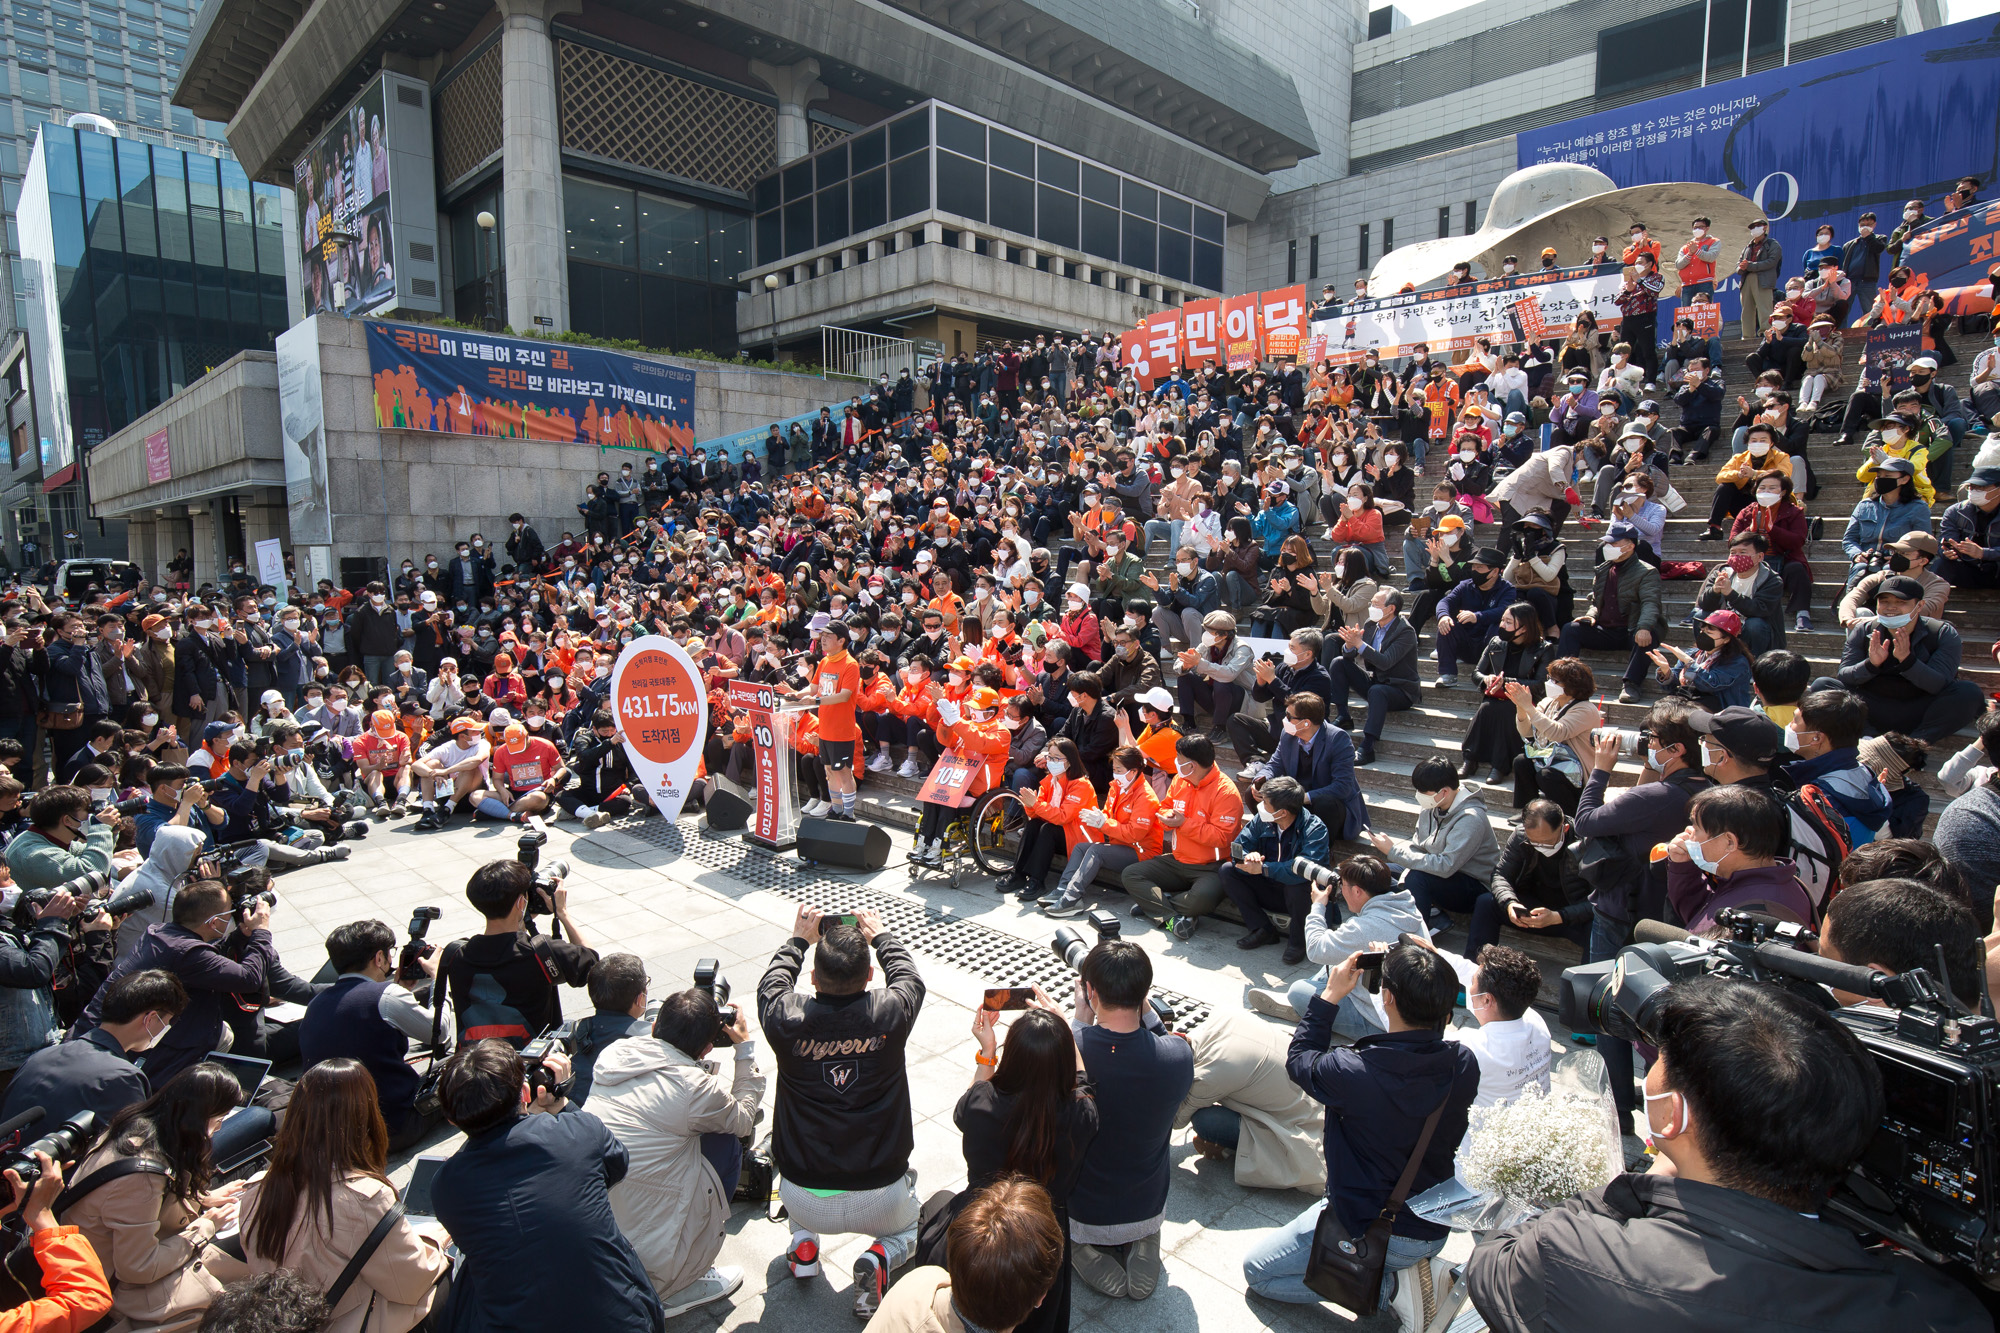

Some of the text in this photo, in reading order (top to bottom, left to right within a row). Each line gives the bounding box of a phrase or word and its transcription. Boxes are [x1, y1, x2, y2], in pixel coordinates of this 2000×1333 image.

[1574, 132, 1604, 147] 예술을
[1607, 127, 1628, 141] 창조
[1631, 122, 1642, 136] 할
[1644, 120, 1656, 131] 수
[1658, 114, 1680, 128] 있는
[1684, 107, 1706, 123] 것은
[1709, 94, 1761, 116] 아니지만,
[1559, 147, 1599, 164] 사람들이
[1601, 140, 1633, 156] 이러한
[1635, 132, 1668, 148] 감정을
[1670, 125, 1693, 140] 가질
[1696, 122, 1708, 134] 수
[1476, 279, 1509, 293] 완주!
[1515, 269, 1597, 285] 축하합니다!
[1375, 311, 1397, 323] 우리
[1401, 305, 1437, 319] 국민은
[1442, 297, 1481, 312] 나라를
[1434, 313, 1471, 327] 당신의
[1473, 324, 1506, 333] 끝까지
[1437, 338, 1471, 350] 함께하는
[463, 341, 511, 364] 만들어
[514, 347, 546, 367] 주신
[551, 349, 574, 372] 길,
[487, 366, 543, 393] 국민만
[547, 376, 605, 398] 바라보고
[634, 656, 668, 669] 도착지점 포인트
[631, 678, 648, 688] 천리길
[821, 680, 833, 696] 10
[622, 693, 698, 718] 431.75KM
[737, 688, 772, 709] 국민의당 10
[755, 714, 766, 724] 기호
[642, 728, 681, 744] 도착지점
[754, 724, 773, 748] 10
[934, 766, 969, 788] 10번
[656, 789, 680, 798] 국민의당
[762, 769, 774, 836] 국민의당
[1979, 1027, 1995, 1036] SONY
[829, 1064, 852, 1086] W
